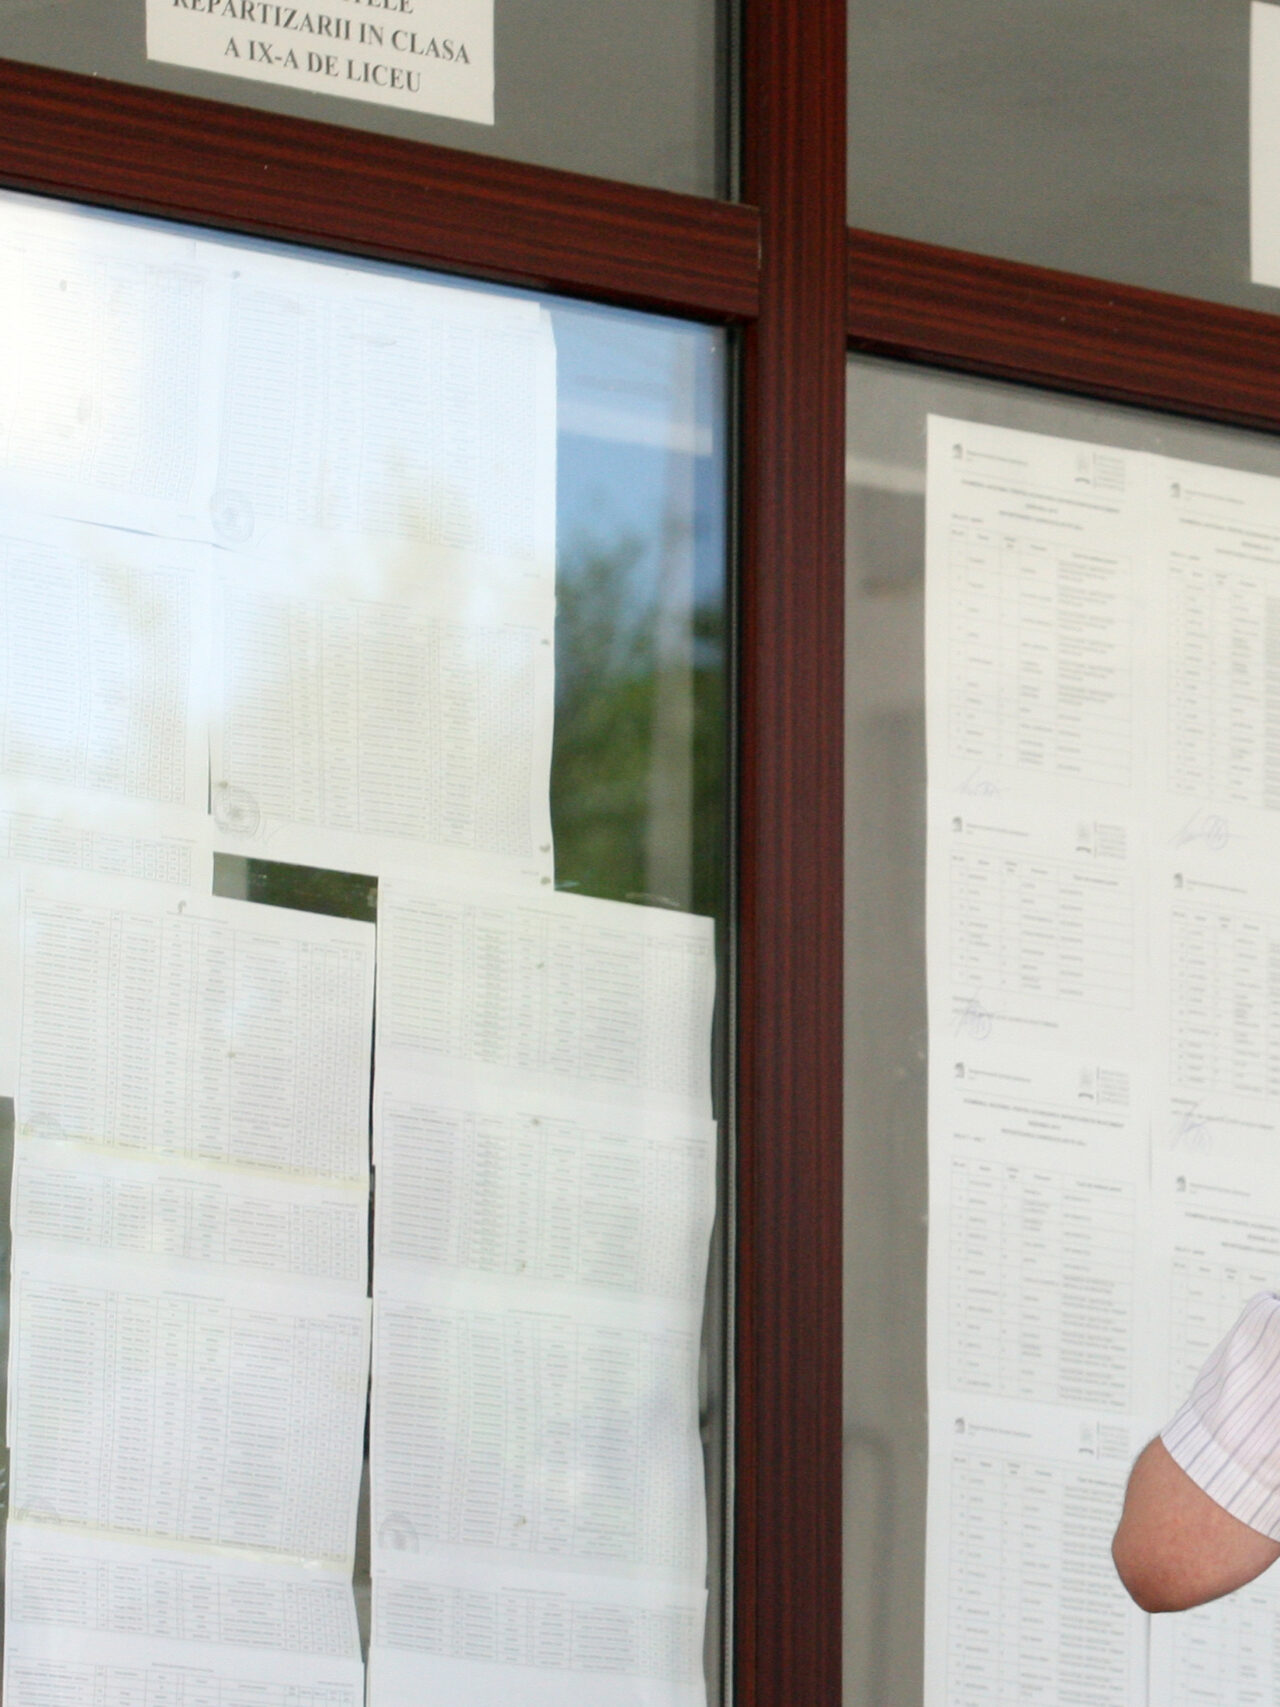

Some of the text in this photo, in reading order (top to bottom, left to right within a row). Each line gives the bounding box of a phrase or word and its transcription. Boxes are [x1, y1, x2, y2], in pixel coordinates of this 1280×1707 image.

[224, 36, 421, 93] A IX-A DE LICEU
[358, 22, 384, 47] IN
[391, 29, 470, 65] CLASA
